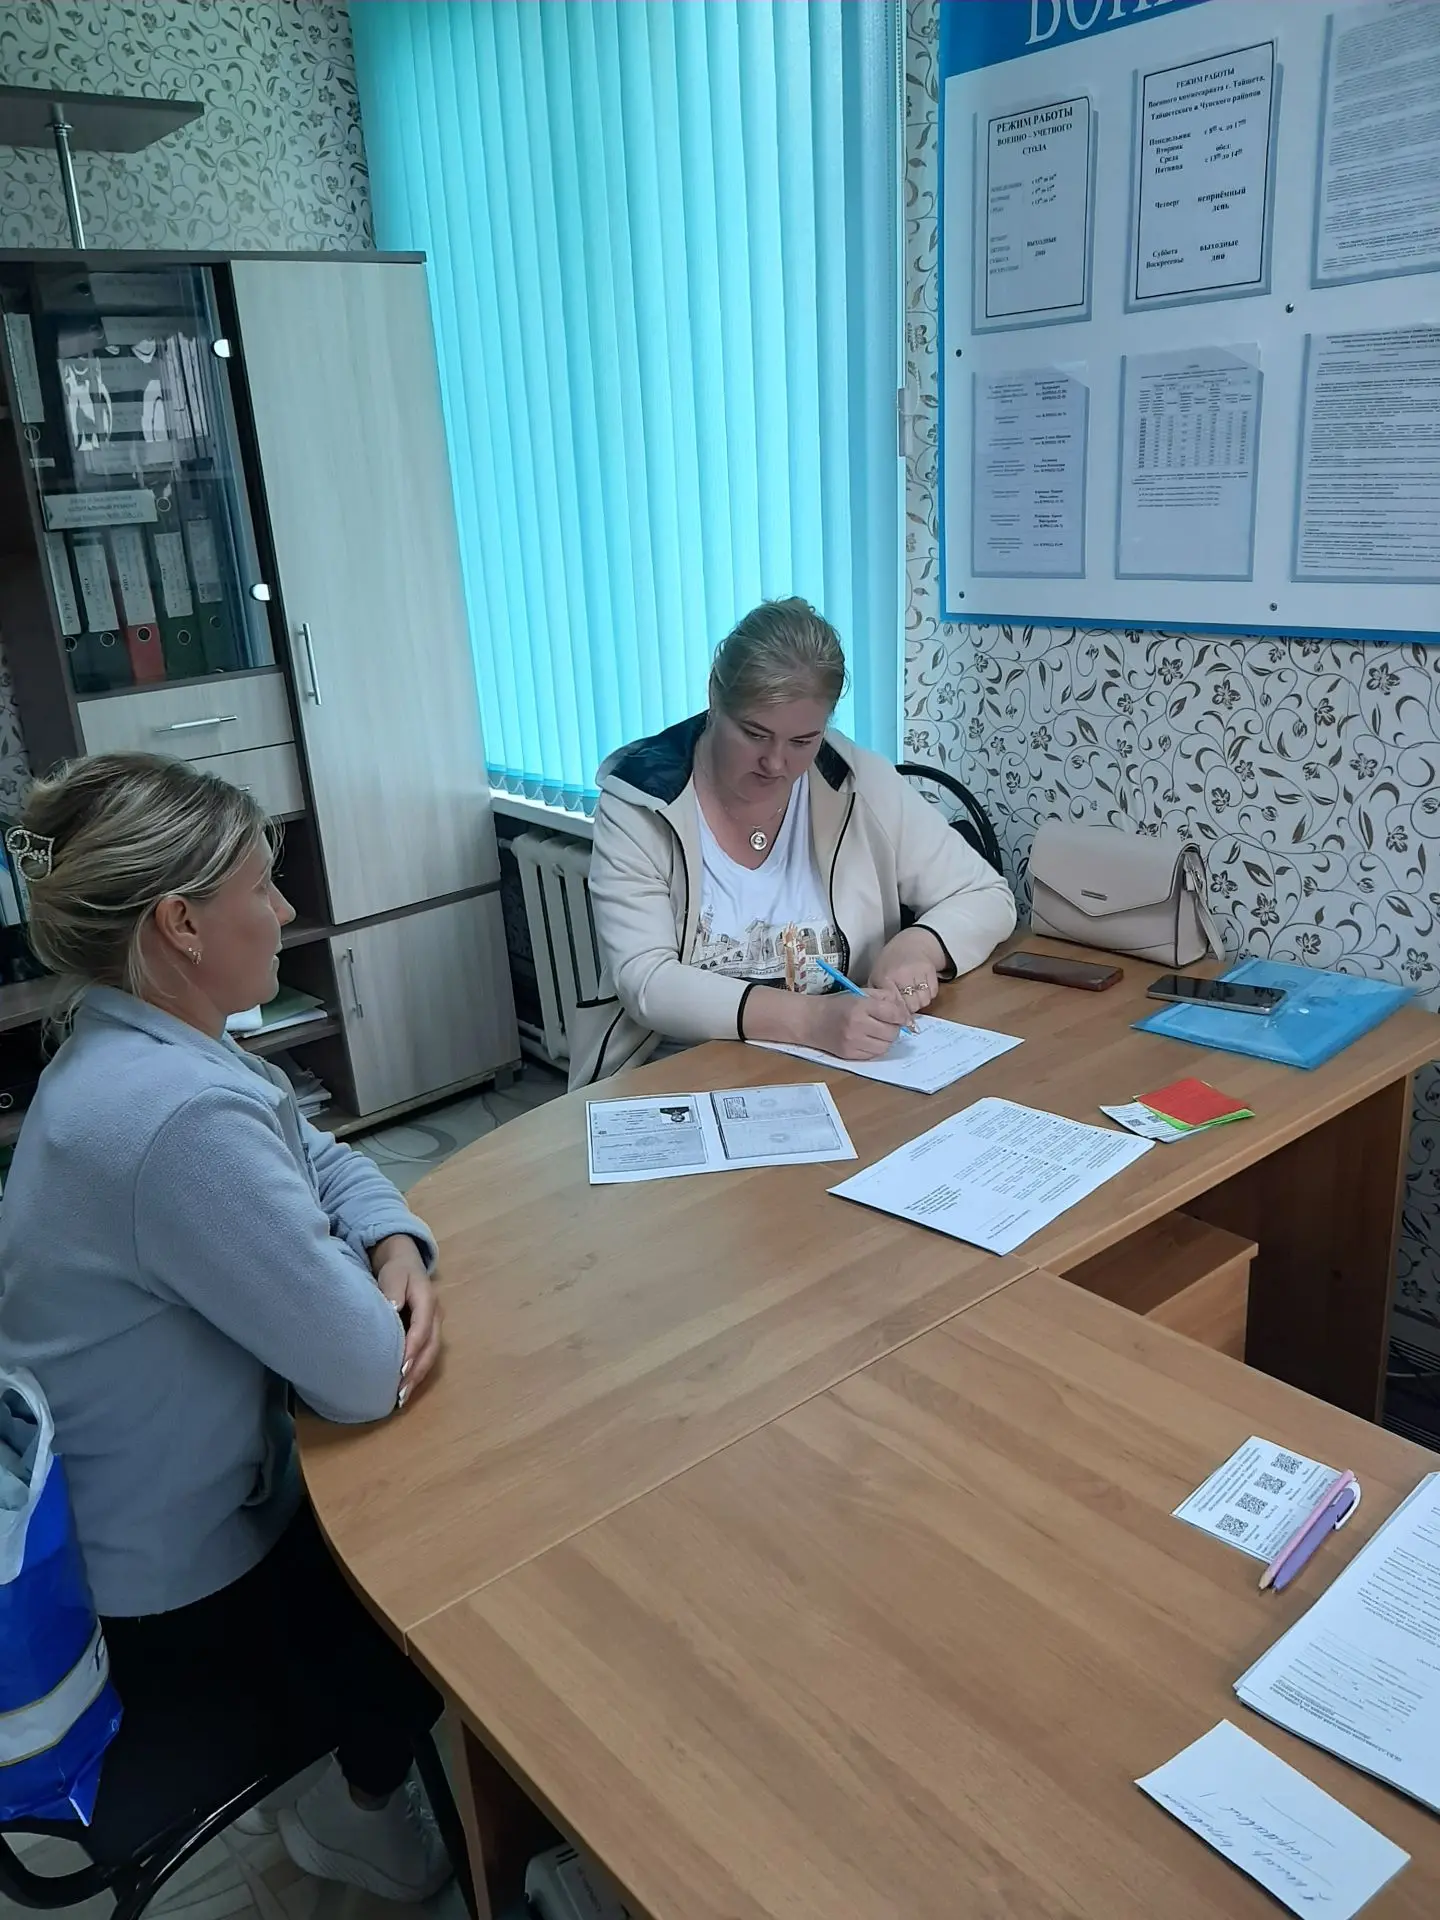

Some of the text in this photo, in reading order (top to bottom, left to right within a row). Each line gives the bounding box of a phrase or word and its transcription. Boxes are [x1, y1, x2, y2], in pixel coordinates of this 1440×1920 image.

[1204, 67, 1234, 81] РАБОТЫ
[996, 107, 1073, 134] РЕЖИМ РАБОТЫ
[1033, 123, 1073, 138] УЧЕТНОГО
[1022, 144, 1047, 155] СТОЛА
[1160, 155, 1179, 164] Среда
[1154, 200, 1180, 209] Четверг
[1199, 240, 1239, 252] выходные
